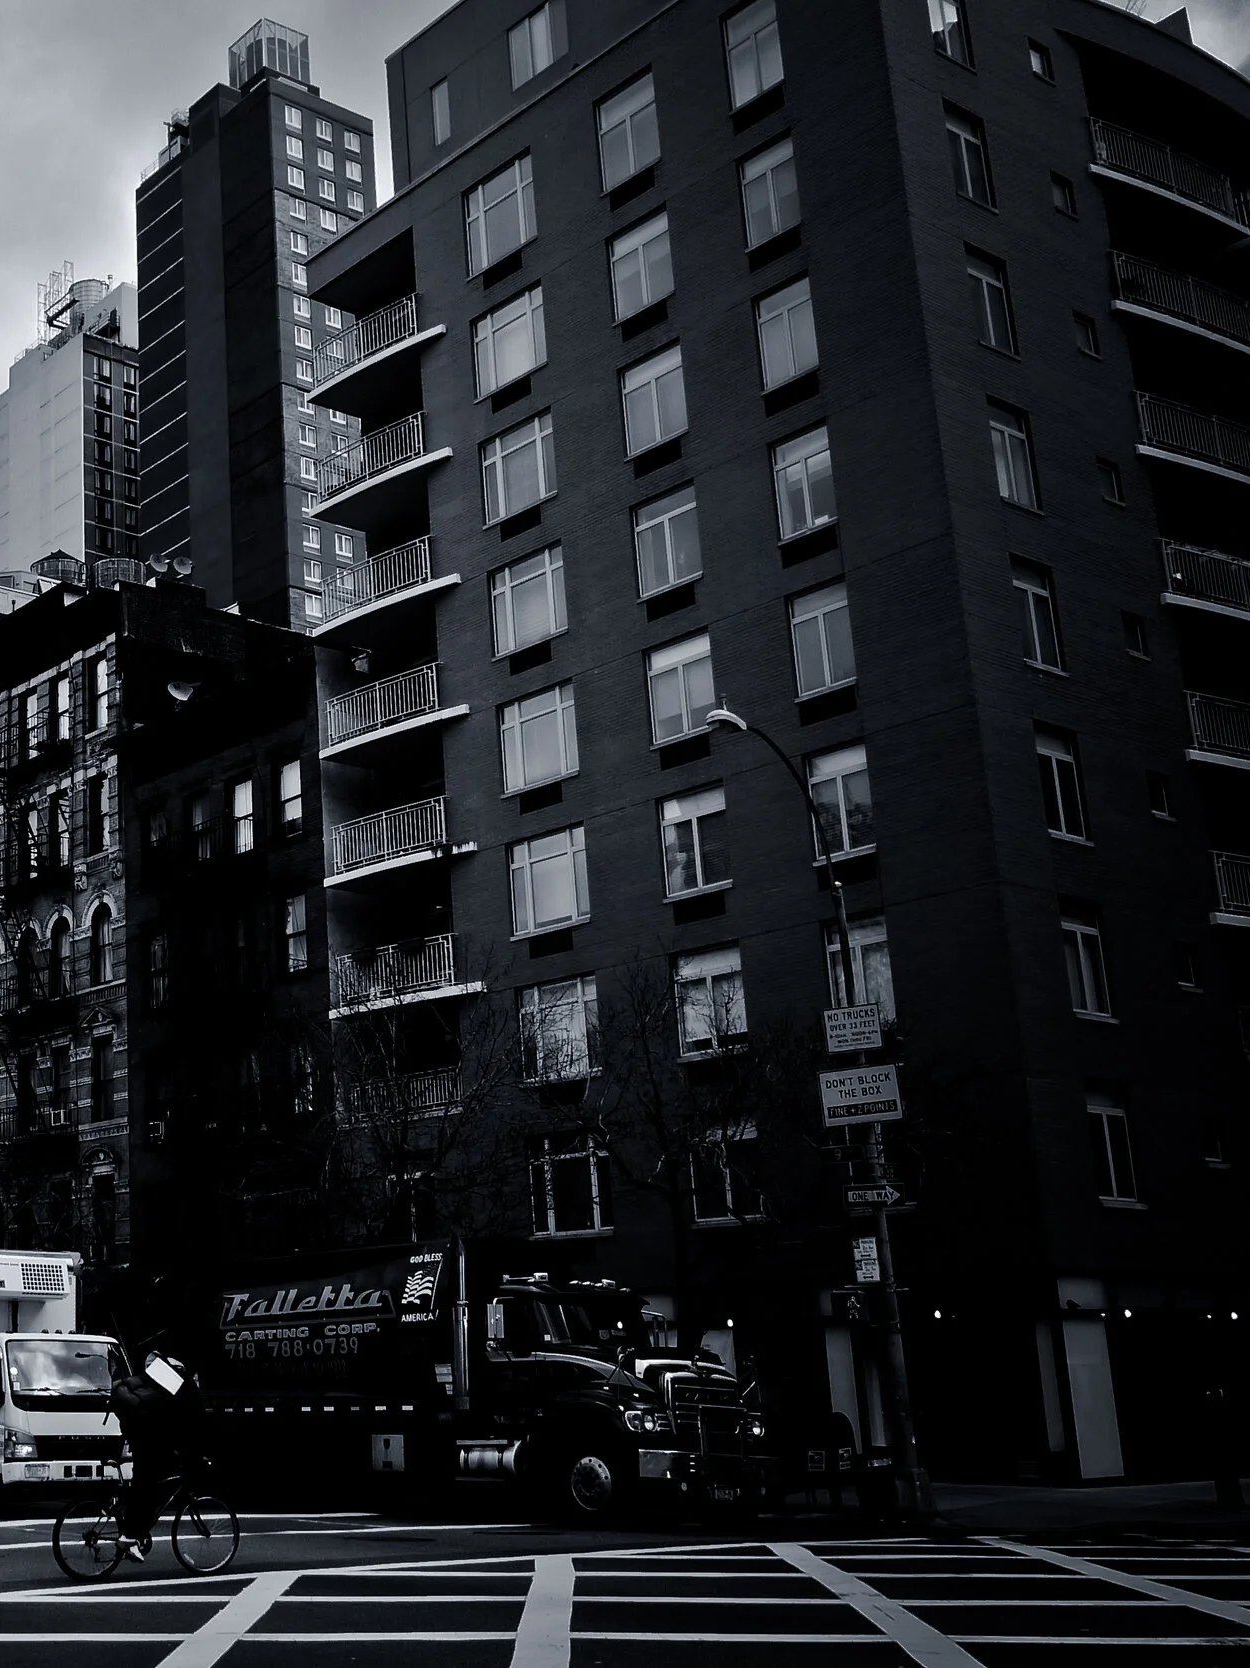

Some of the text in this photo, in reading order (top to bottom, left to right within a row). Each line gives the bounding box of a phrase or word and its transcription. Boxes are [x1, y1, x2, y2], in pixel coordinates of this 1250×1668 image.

[828, 1008, 875, 1022] NO TRUCKS
[830, 1020, 875, 1032] OVER 33 FEET
[825, 1072, 891, 1089] DON'T BLOCK
[838, 1085, 882, 1099] THE BOX
[830, 1106, 849, 1117] FINE
[857, 1105, 863, 1114] 2
[864, 1101, 895, 1113] POINTS
[852, 1191, 894, 1201] ONE WAY
[409, 1252, 443, 1263] GOD BLESS
[223, 1283, 382, 1322] Falletta
[225, 1322, 381, 1342] CARTING CORP.
[225, 1342, 256, 1360] 718
